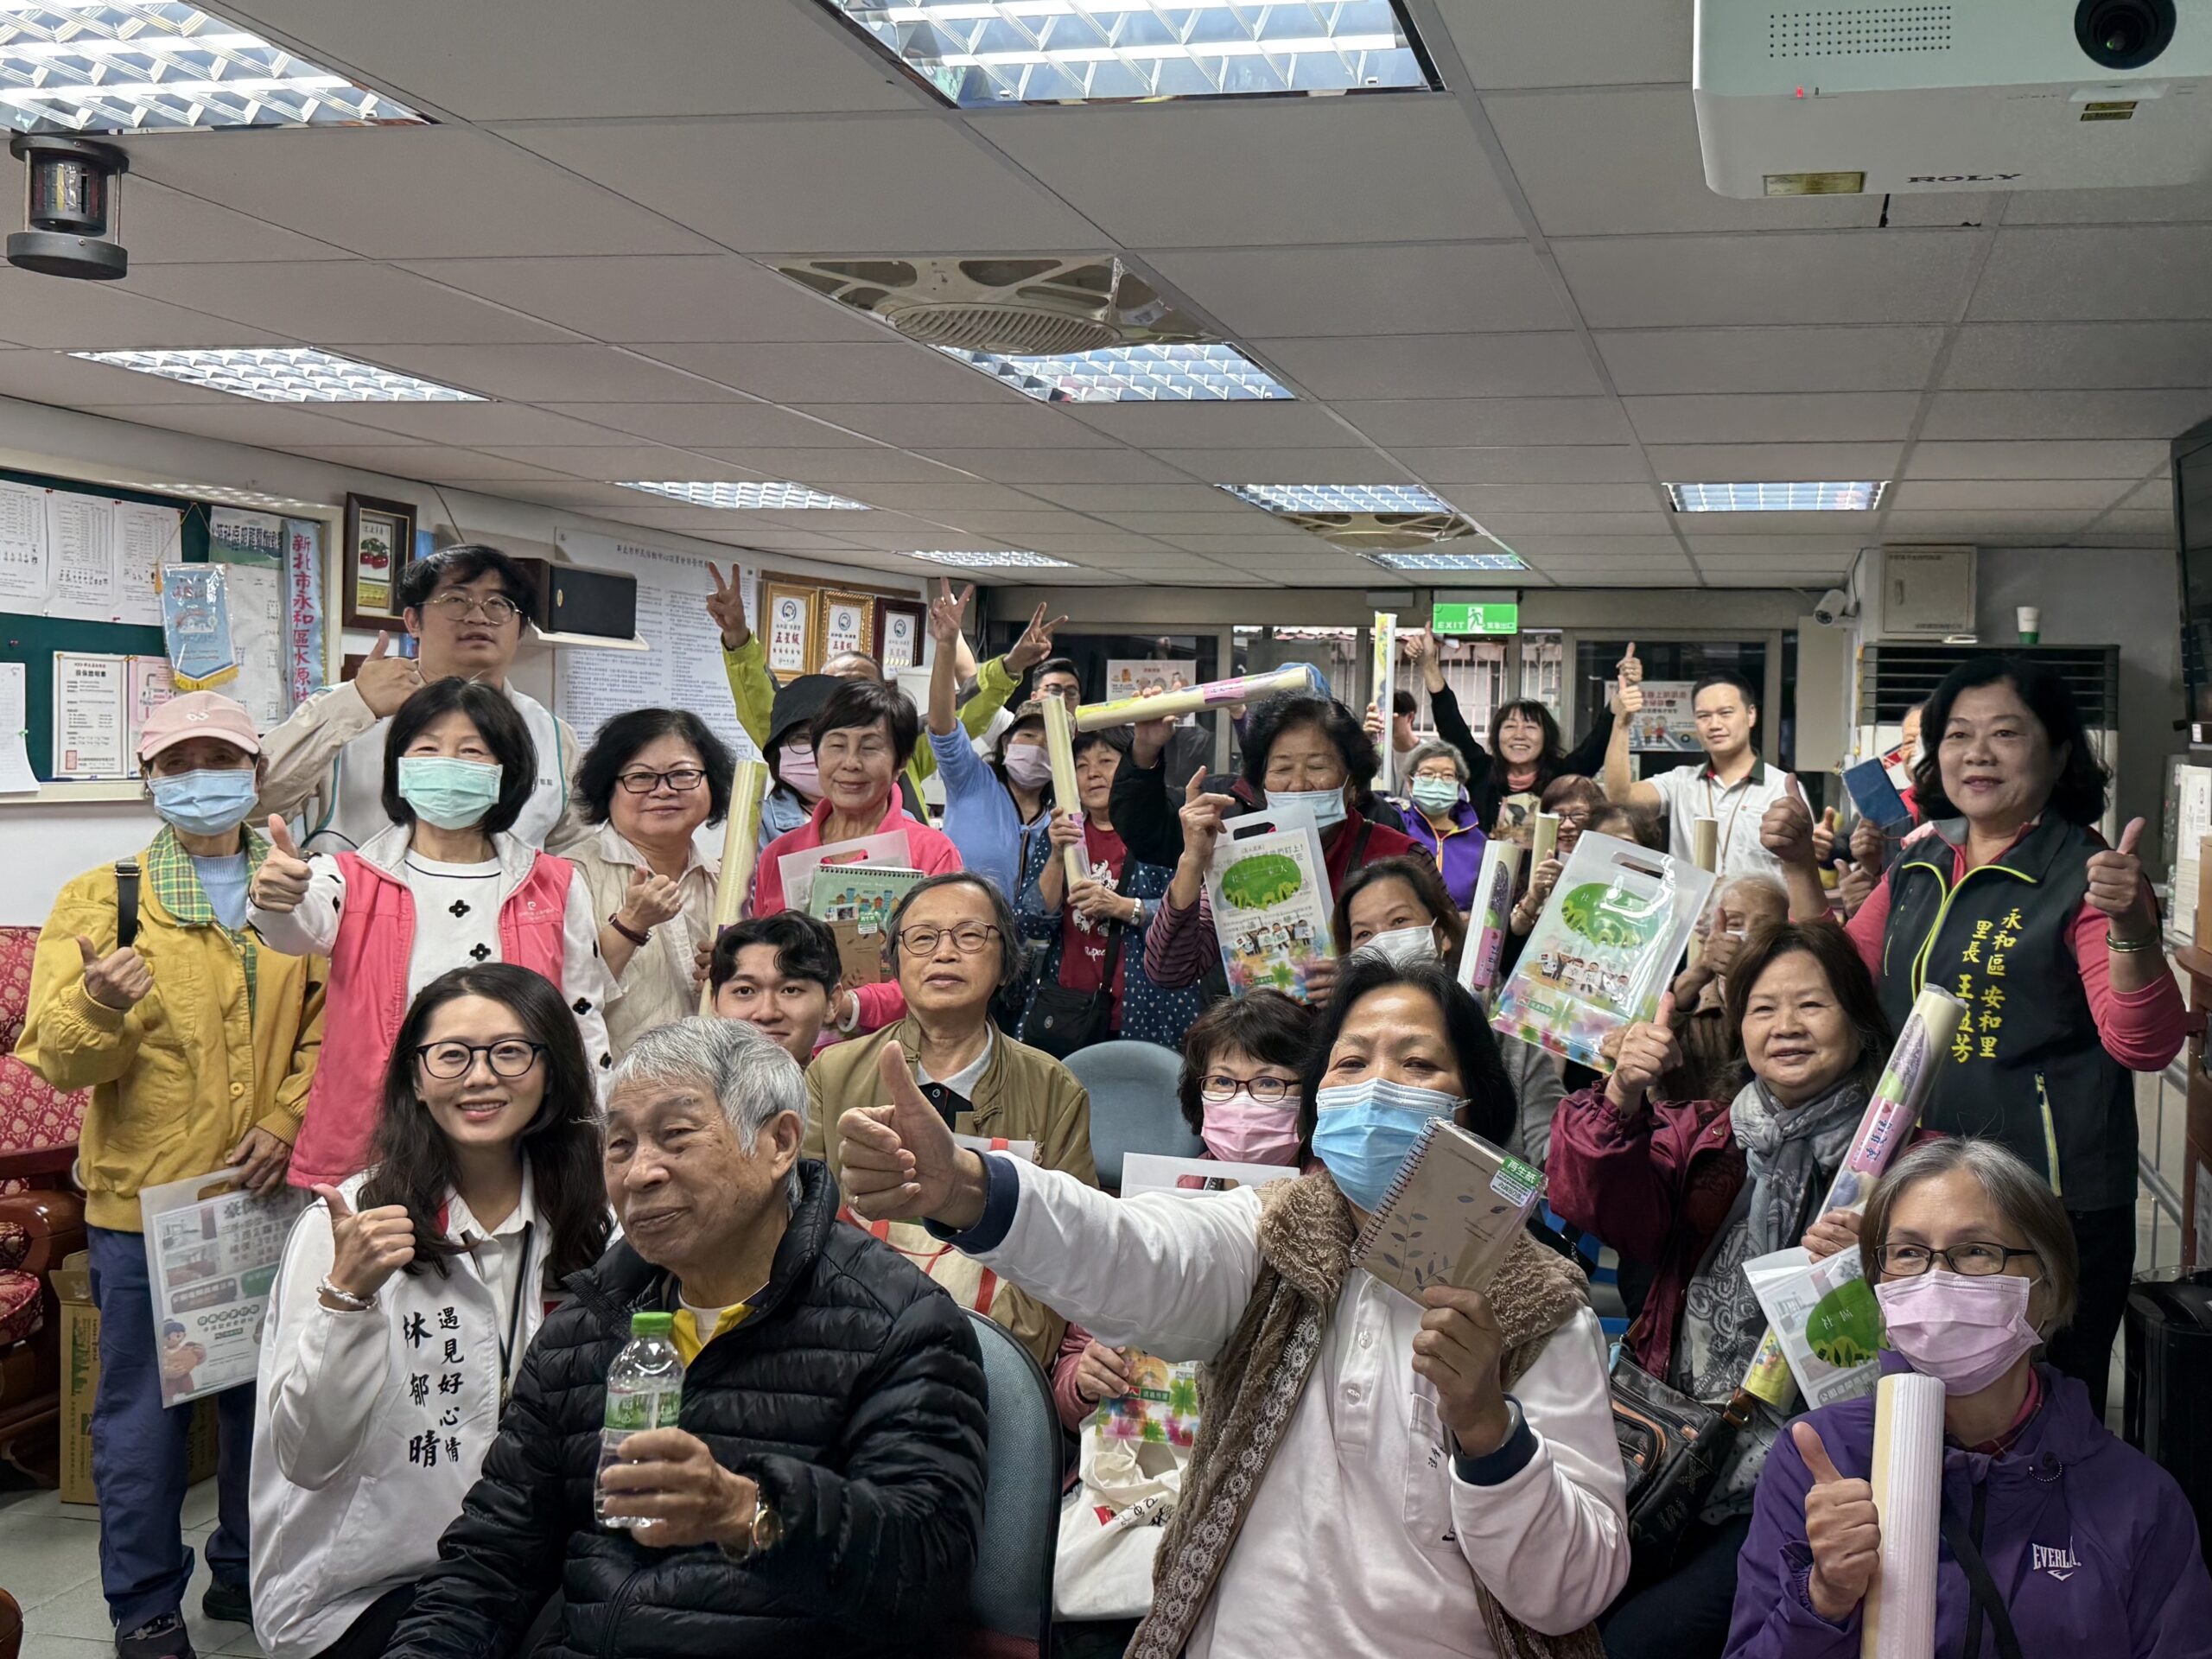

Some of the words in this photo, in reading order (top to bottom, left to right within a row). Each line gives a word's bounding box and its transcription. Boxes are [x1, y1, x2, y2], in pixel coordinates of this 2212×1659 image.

[1907, 173, 2024, 184] ROLY
[1961, 920, 1993, 963] 里長
[1986, 908, 2023, 976] 永和區
[1979, 984, 2005, 1058] 安和里
[1507, 1161, 1536, 1184] 再生紙
[437, 1306, 464, 1463] 遇見好心情
